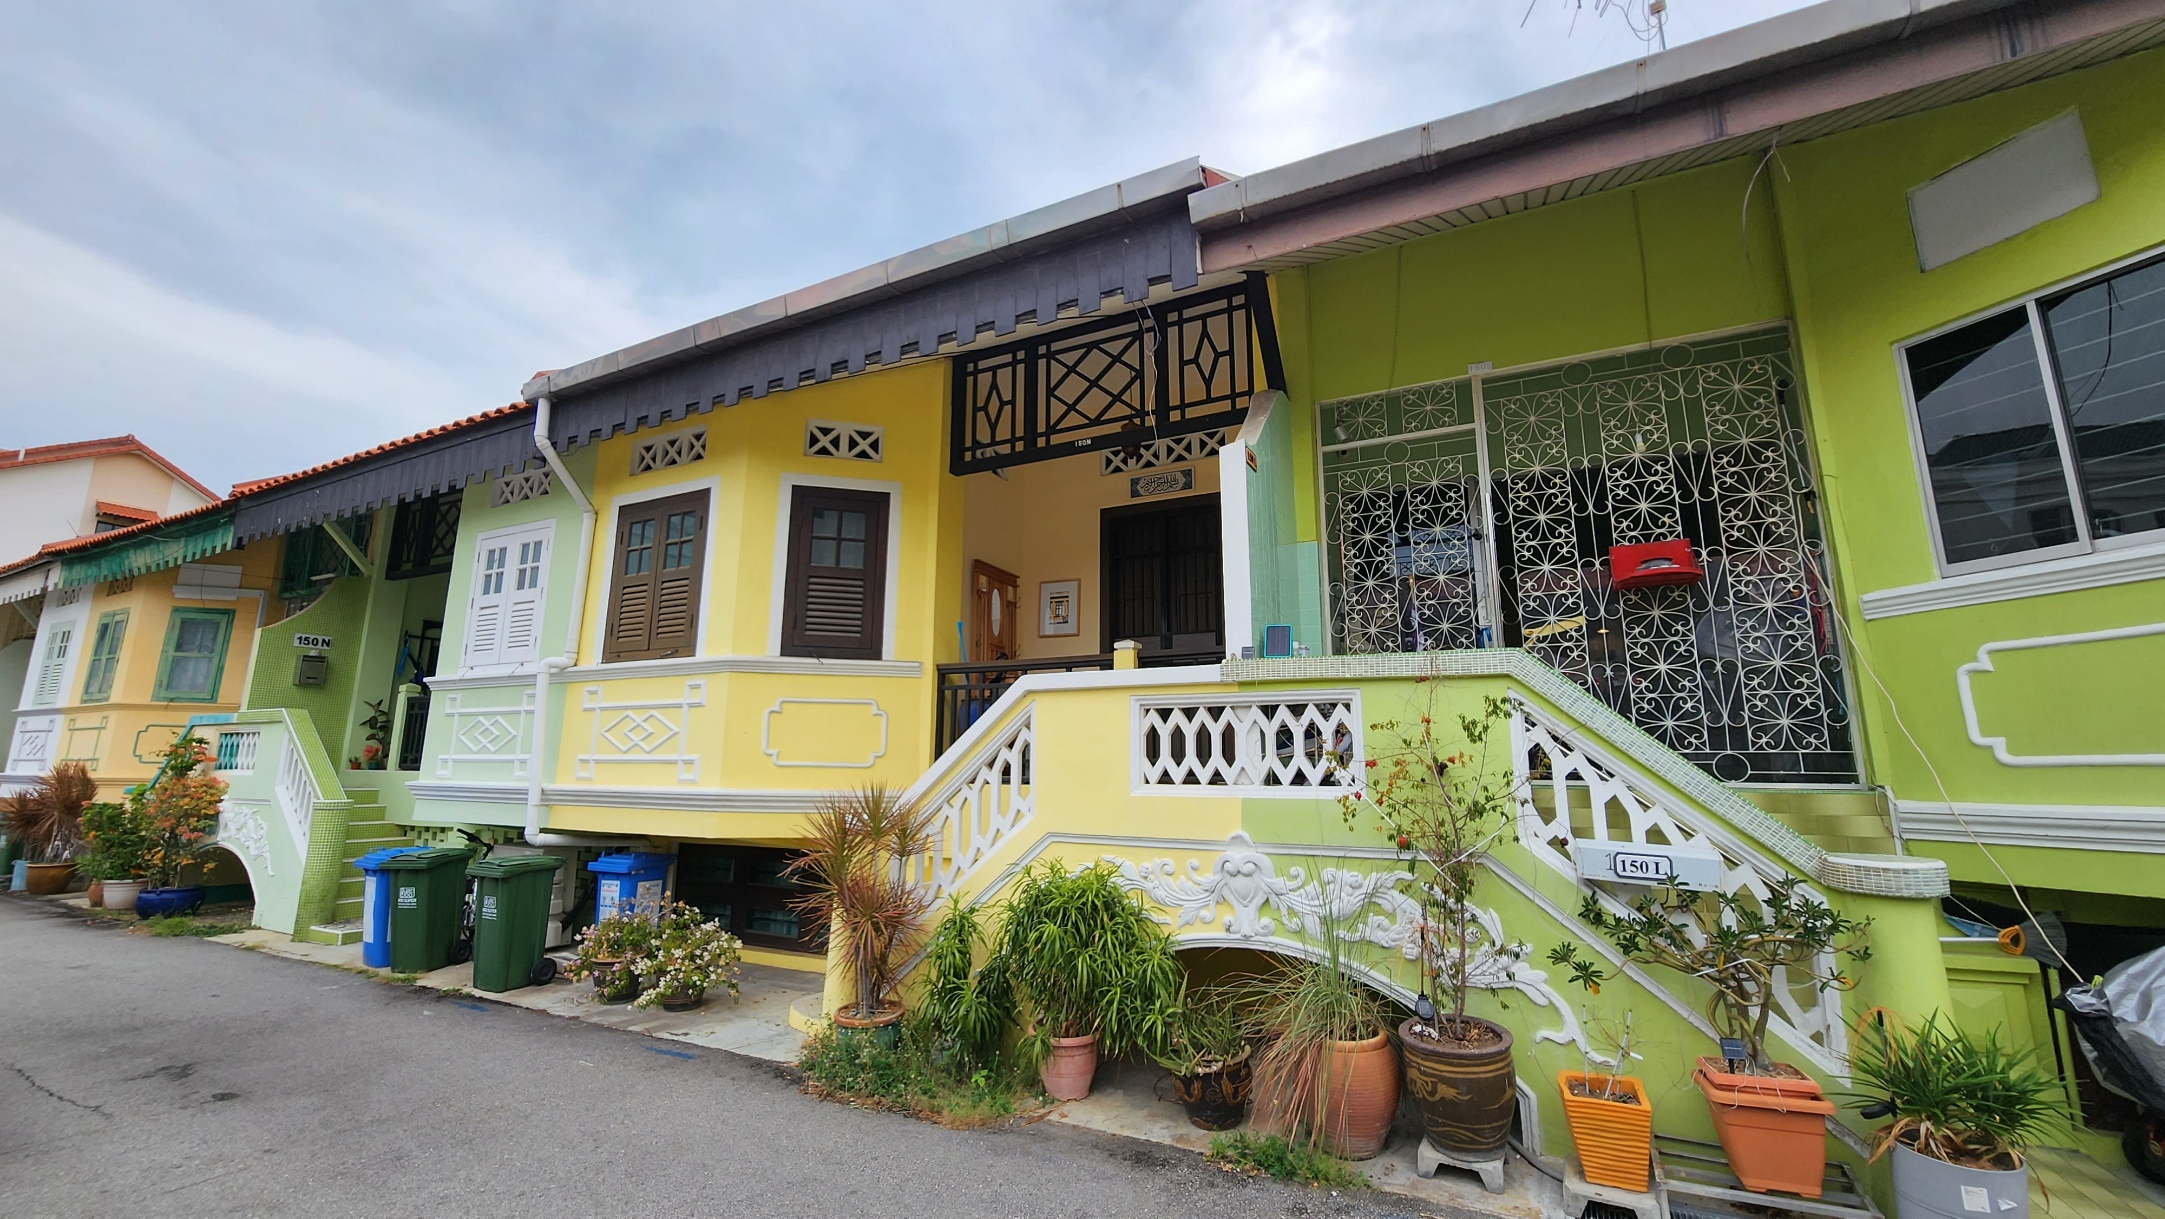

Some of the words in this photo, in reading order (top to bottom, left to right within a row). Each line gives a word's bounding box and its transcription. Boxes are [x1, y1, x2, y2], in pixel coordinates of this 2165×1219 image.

[296, 635, 319, 647] 150
[320, 638, 331, 648] N
[1620, 859, 1649, 875] 150
[1653, 861, 1668, 876] L
